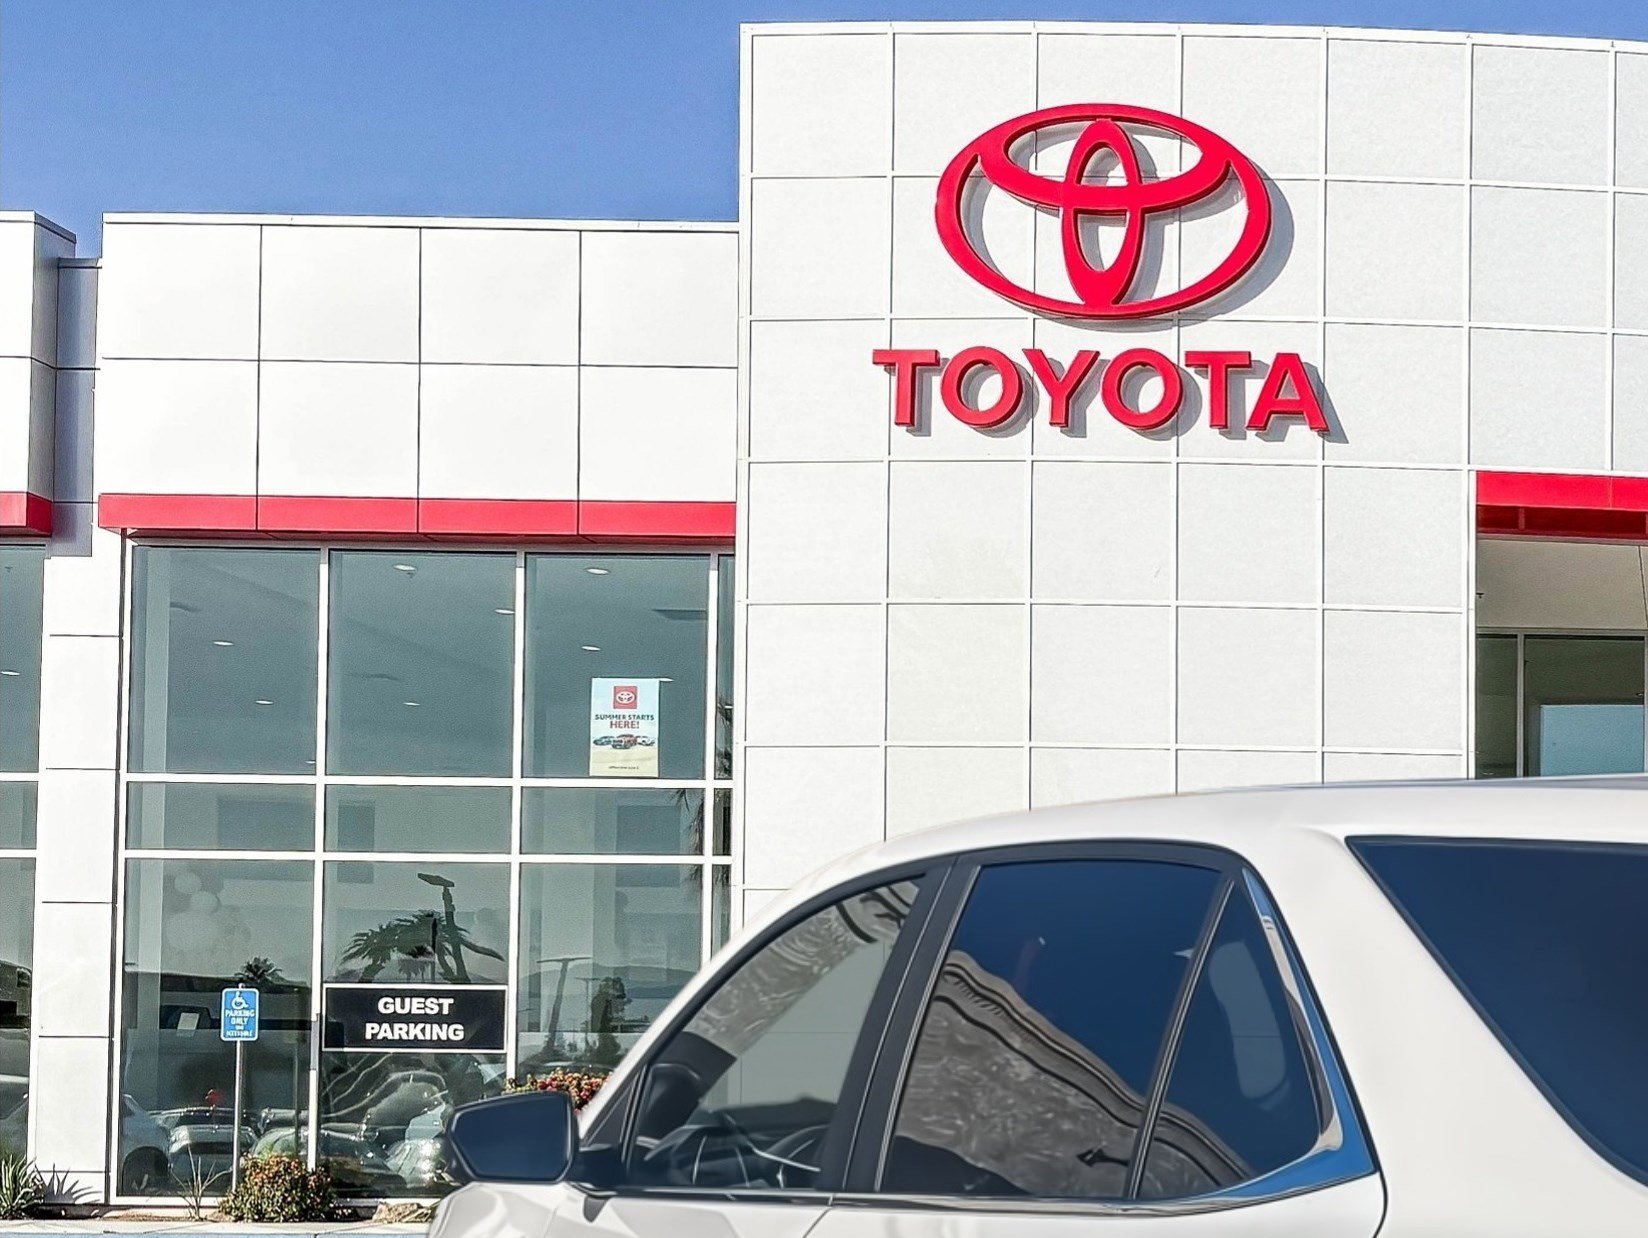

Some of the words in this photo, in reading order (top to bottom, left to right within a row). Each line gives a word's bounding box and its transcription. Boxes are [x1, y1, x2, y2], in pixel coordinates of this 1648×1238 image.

[872, 346, 1330, 432] TOYOTA
[609, 720, 640, 729] HERE!
[378, 997, 454, 1015] GUEST
[225, 1009, 255, 1017] PARKING
[230, 1017, 249, 1025] ONLY
[365, 1023, 465, 1041] PARKING
